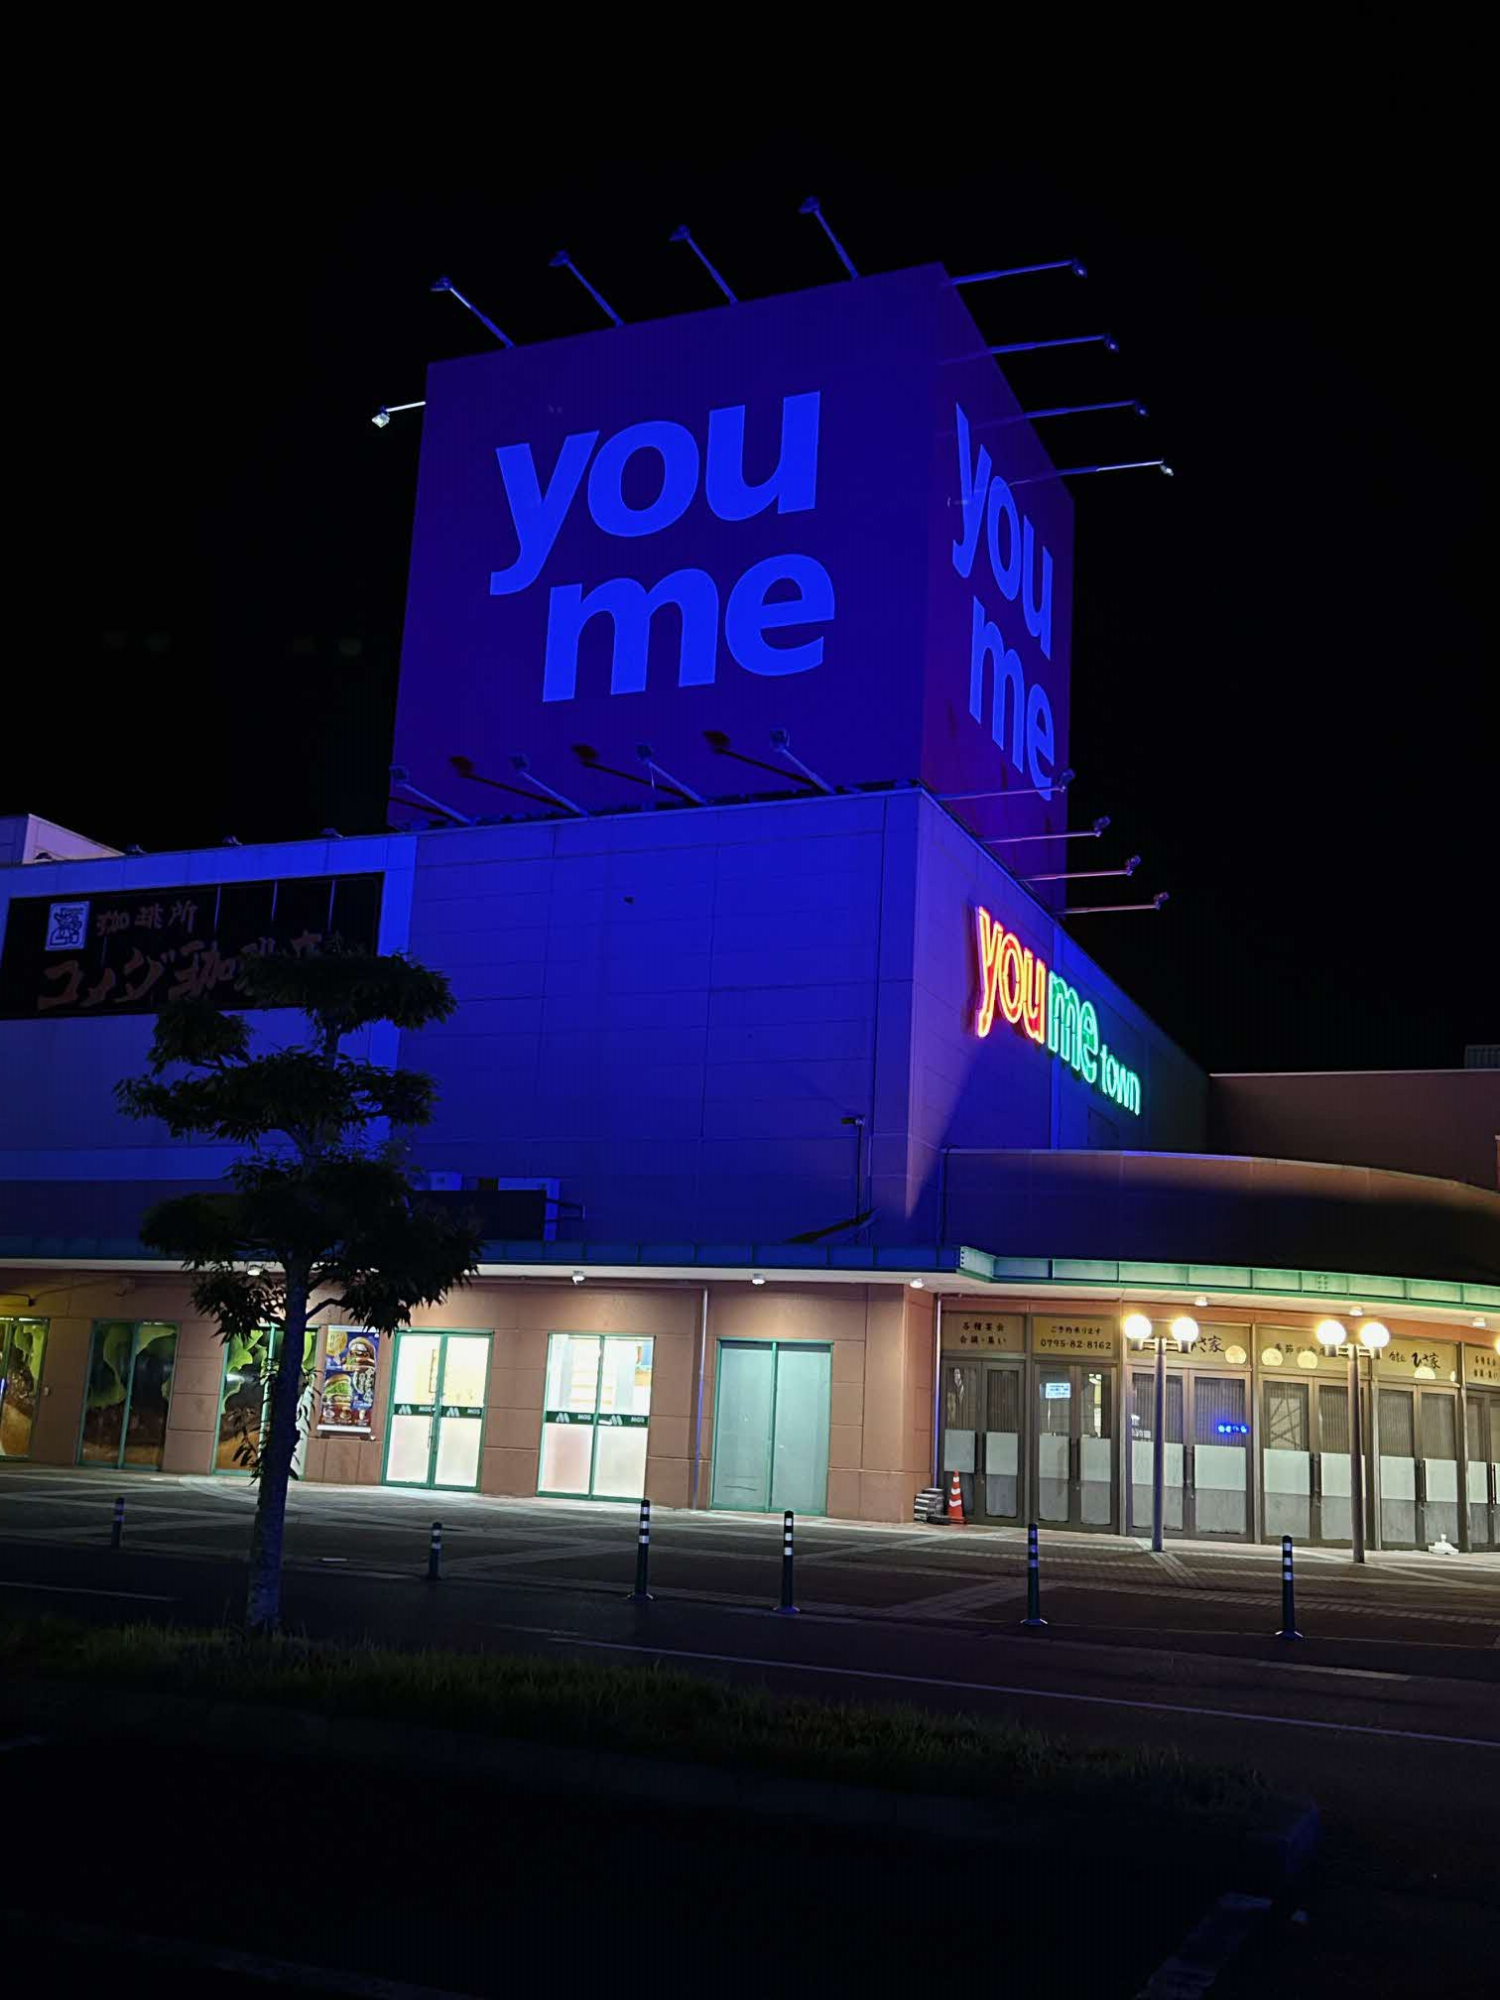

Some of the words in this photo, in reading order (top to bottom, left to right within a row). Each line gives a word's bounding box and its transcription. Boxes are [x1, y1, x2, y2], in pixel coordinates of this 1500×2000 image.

[490, 392, 823, 596] you
[952, 402, 1053, 661] you
[541, 553, 836, 703] me
[969, 595, 1055, 801] me
[1099, 1044, 1142, 1115] town
